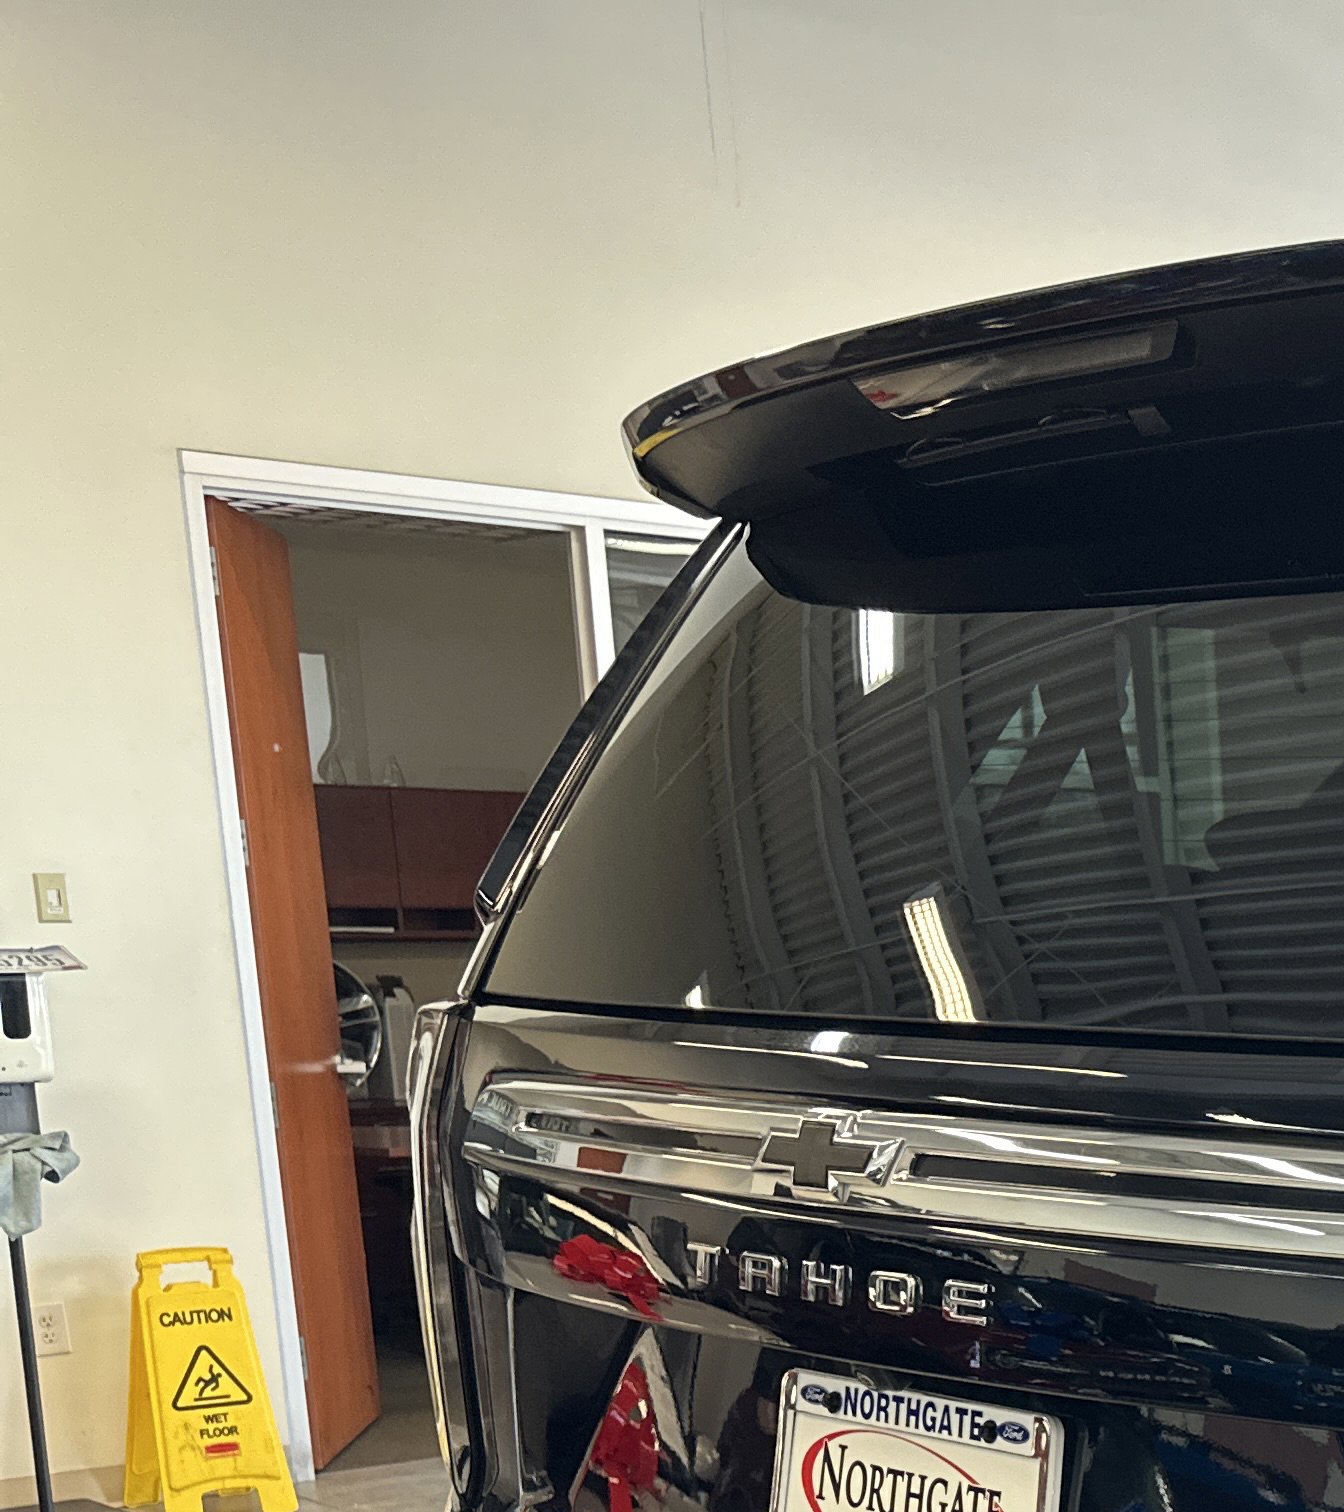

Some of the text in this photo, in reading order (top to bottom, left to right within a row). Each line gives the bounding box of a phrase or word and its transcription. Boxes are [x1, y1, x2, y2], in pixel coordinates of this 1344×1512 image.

[686, 1242, 992, 1327] TAHOE
[159, 1307, 233, 1327] CAUTION
[203, 1413, 229, 1425] WET
[843, 1385, 983, 1441] NORTHGATE
[200, 1426, 239, 1440] FLOOR
